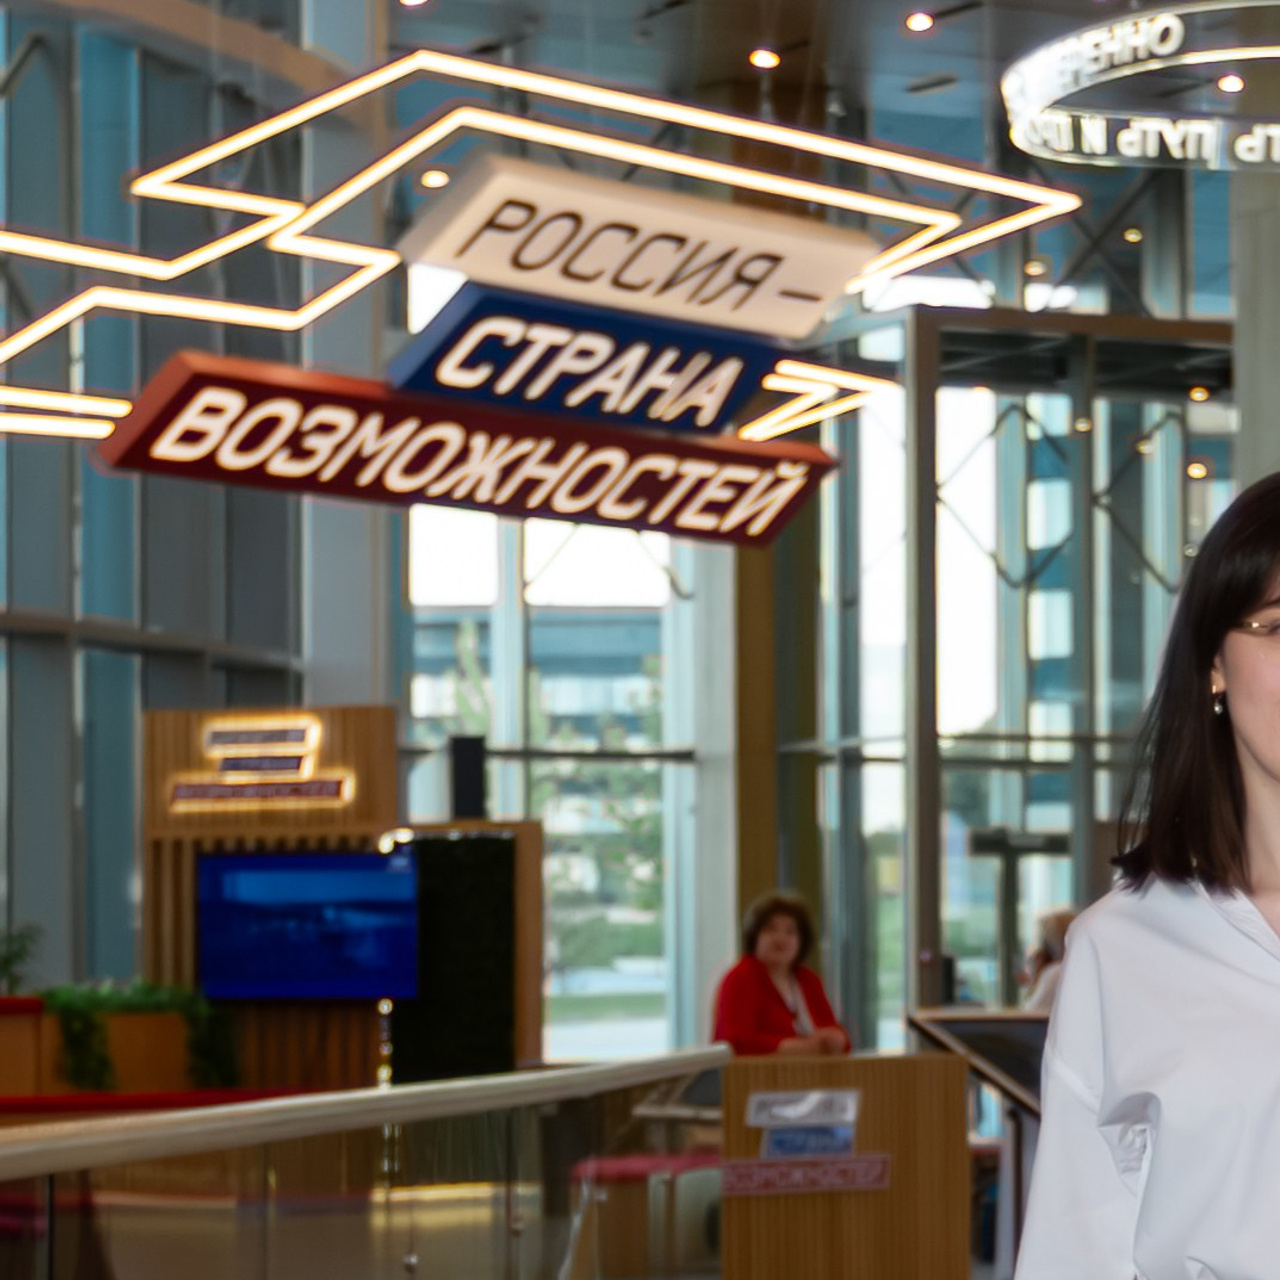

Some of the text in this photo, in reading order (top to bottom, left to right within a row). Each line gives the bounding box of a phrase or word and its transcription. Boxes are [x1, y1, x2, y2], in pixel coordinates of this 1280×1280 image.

[453, 198, 785, 312] РОССИЯ
[434, 314, 745, 428] СТРАНА
[149, 386, 810, 537] ВОЗМОЖНОСТЕЙ
